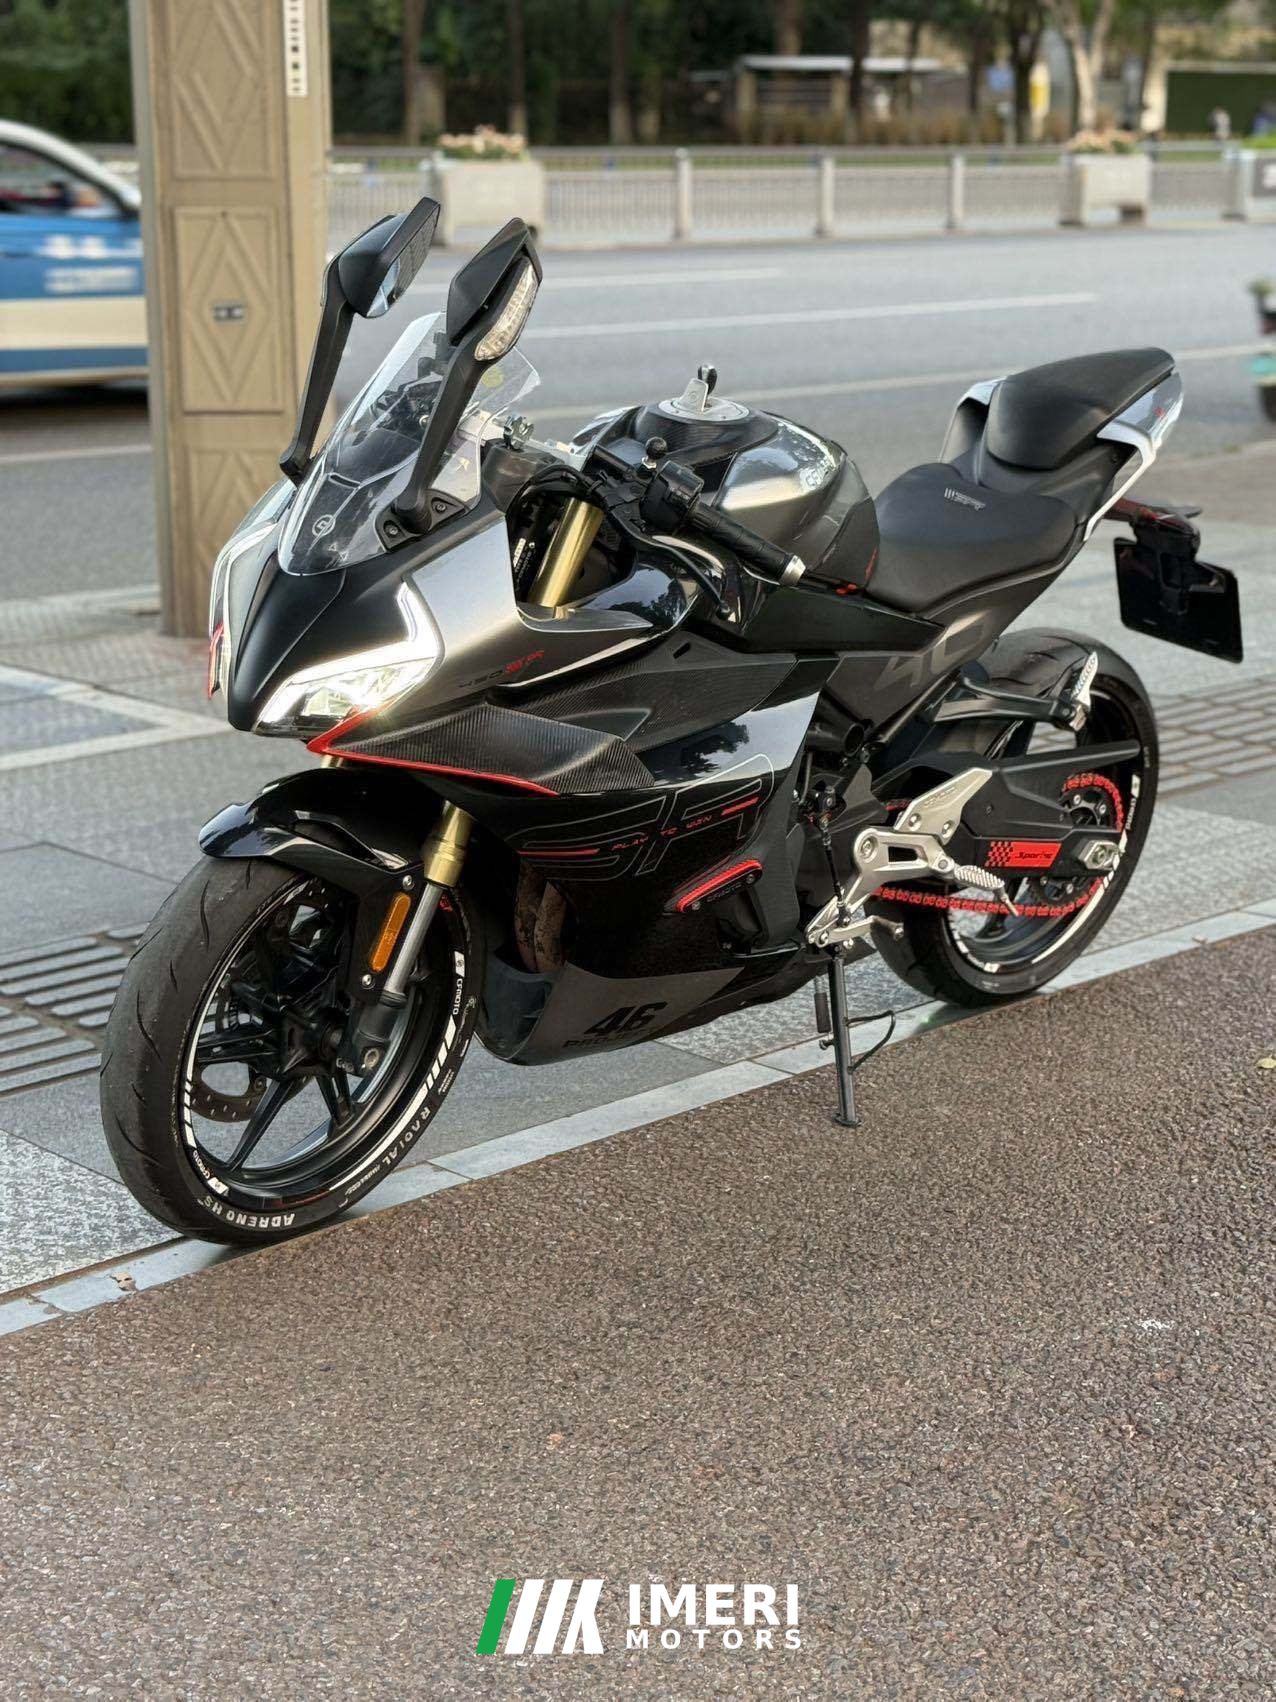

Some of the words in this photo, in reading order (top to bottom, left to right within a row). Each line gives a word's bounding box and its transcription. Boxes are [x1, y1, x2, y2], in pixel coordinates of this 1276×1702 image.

[583, 1001, 668, 1035] 46
[382, 1106, 431, 1166] RADIAL
[226, 1210, 296, 1229] ADRENO
